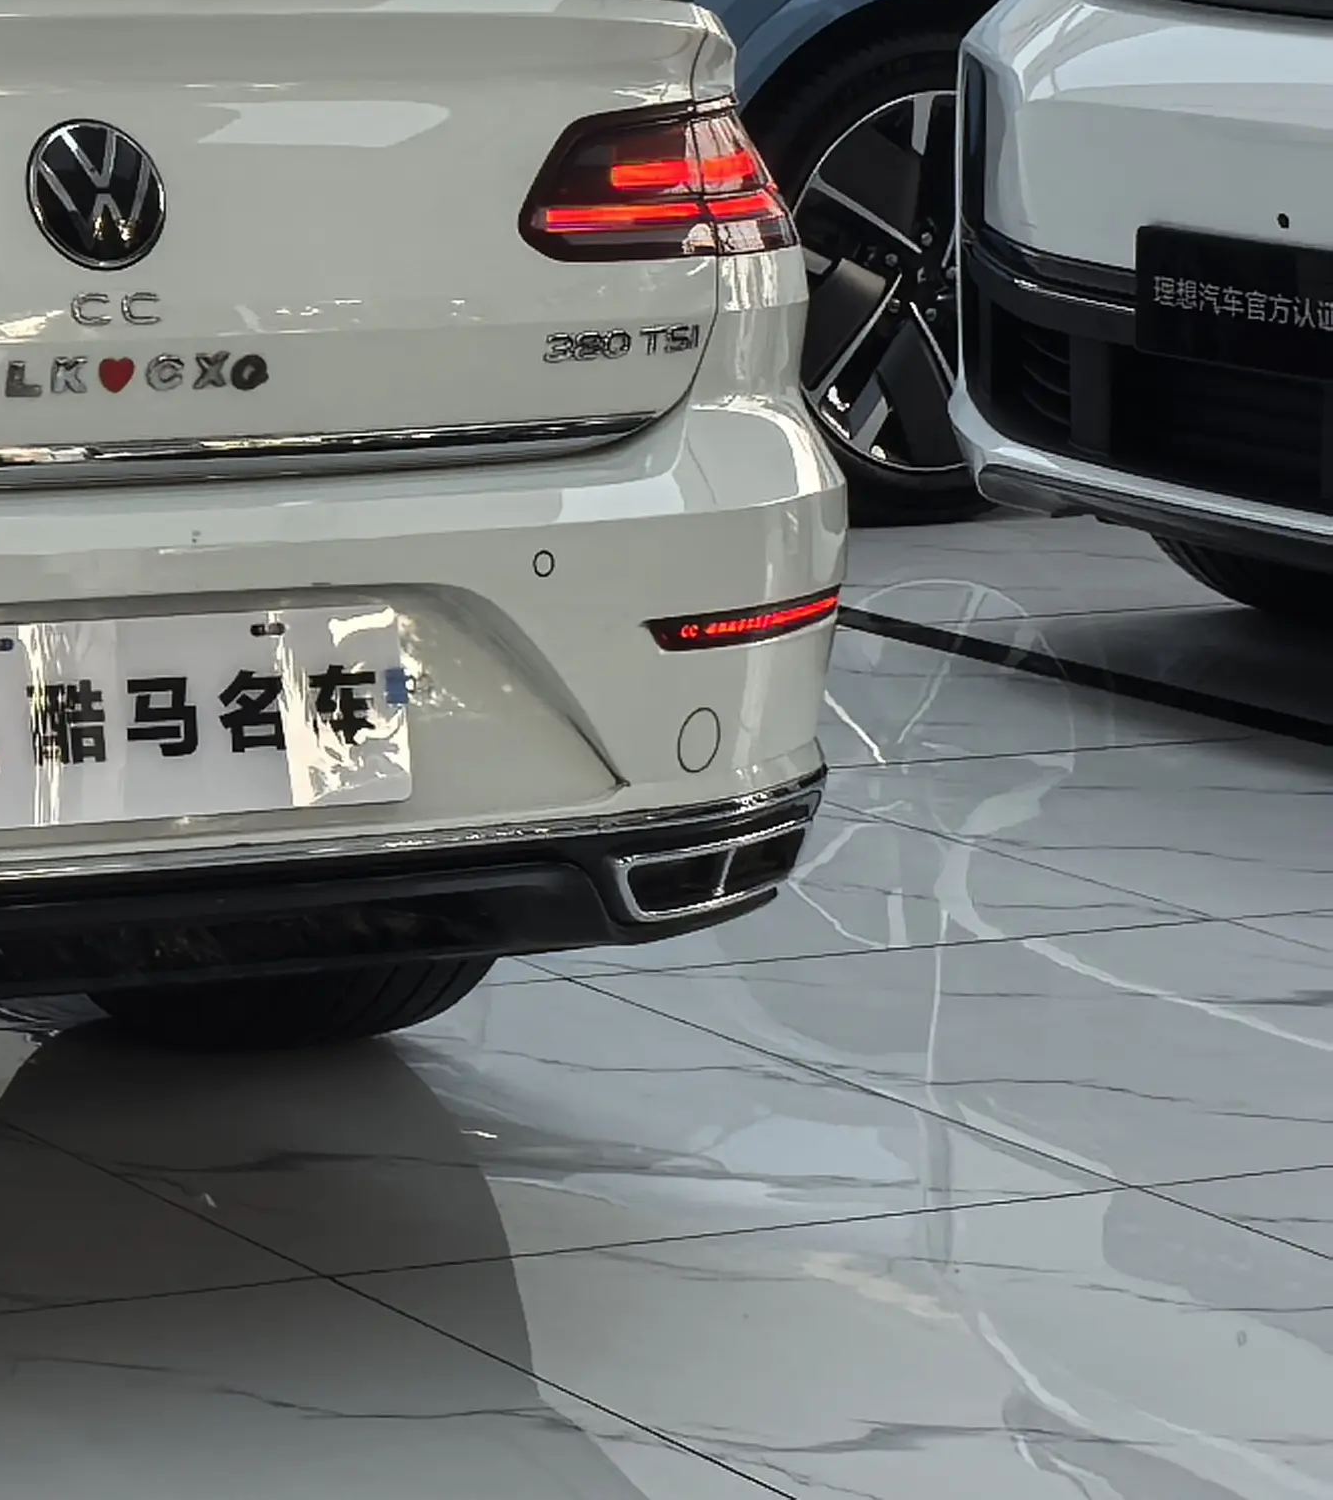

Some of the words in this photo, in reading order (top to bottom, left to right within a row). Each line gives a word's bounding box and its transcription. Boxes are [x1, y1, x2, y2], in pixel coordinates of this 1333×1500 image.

[70, 292, 161, 326] CC
[639, 323, 699, 356] TSI
[27, 664, 377, 766] 酷马名车
